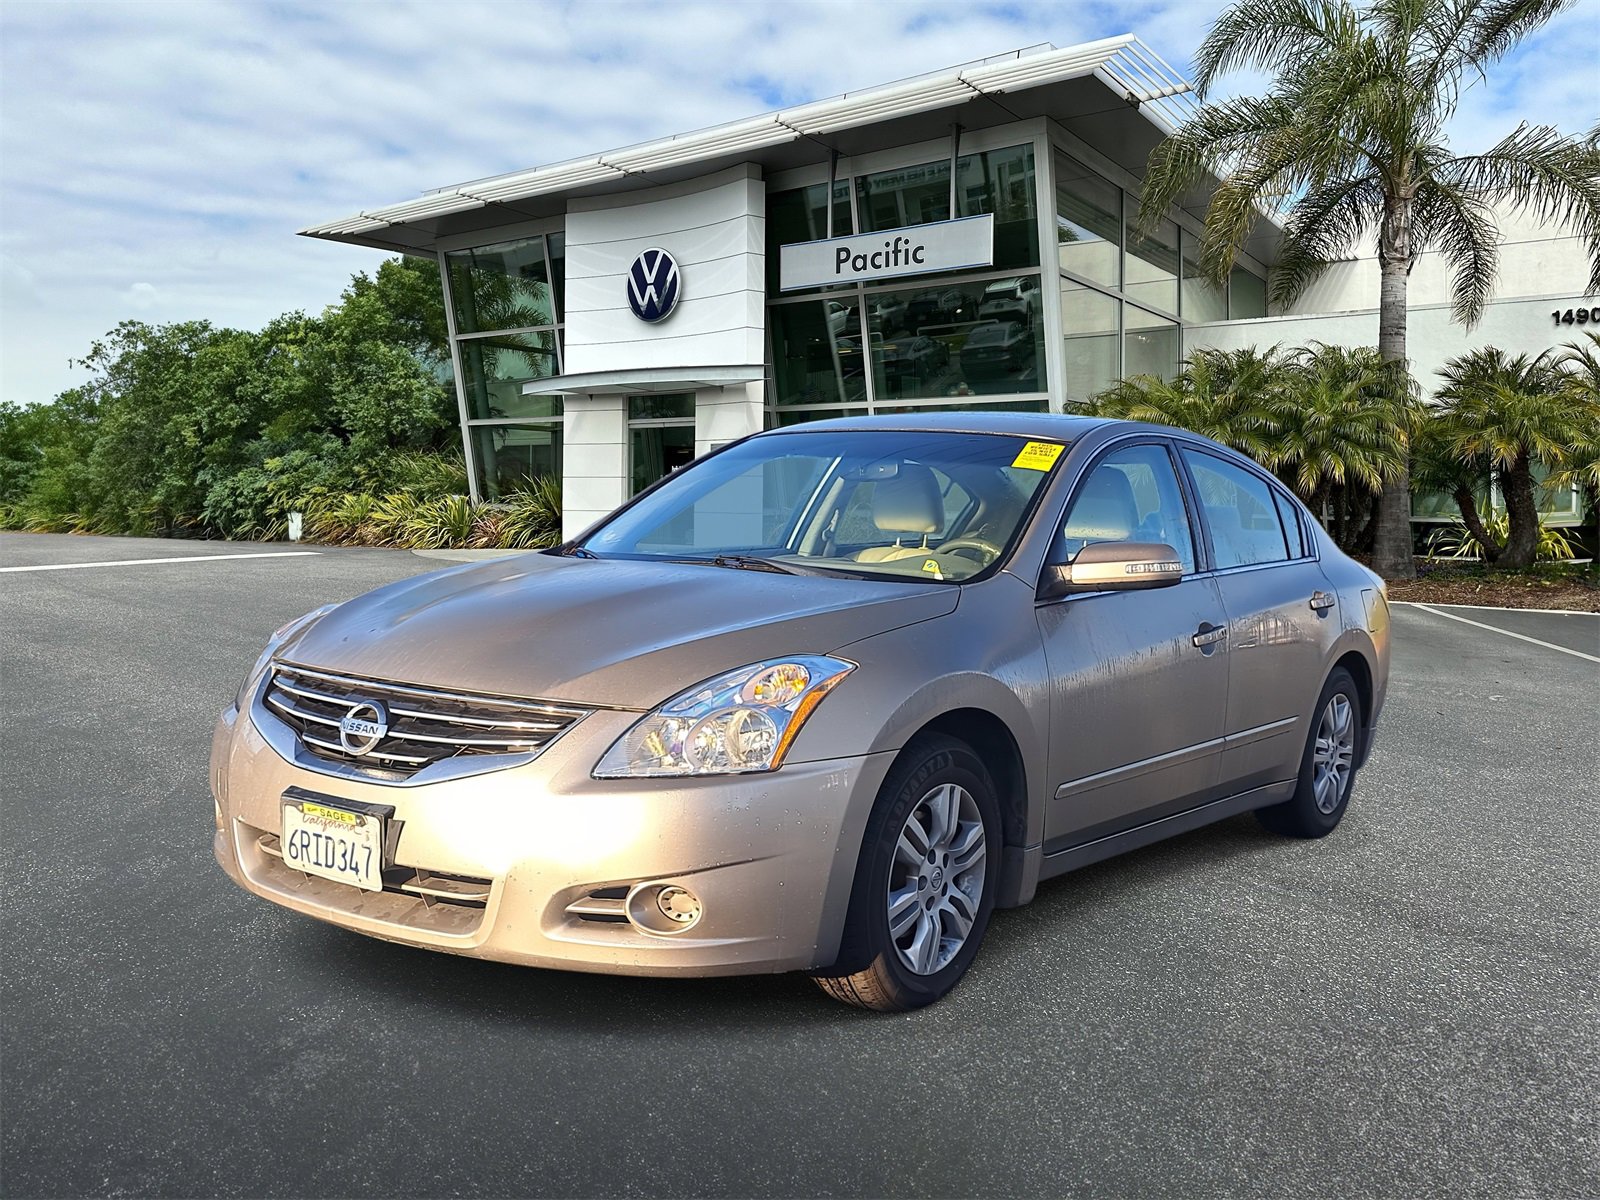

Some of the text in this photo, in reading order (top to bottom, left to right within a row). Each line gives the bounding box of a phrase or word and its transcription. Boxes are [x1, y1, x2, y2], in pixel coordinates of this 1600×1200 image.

[835, 236, 925, 274] Pacific
[627, 249, 679, 319] VW
[1552, 307, 1600, 326] 1490
[342, 720, 379, 735] NISSAN
[319, 808, 346, 822] SAGE
[288, 829, 372, 880] 6RID347
